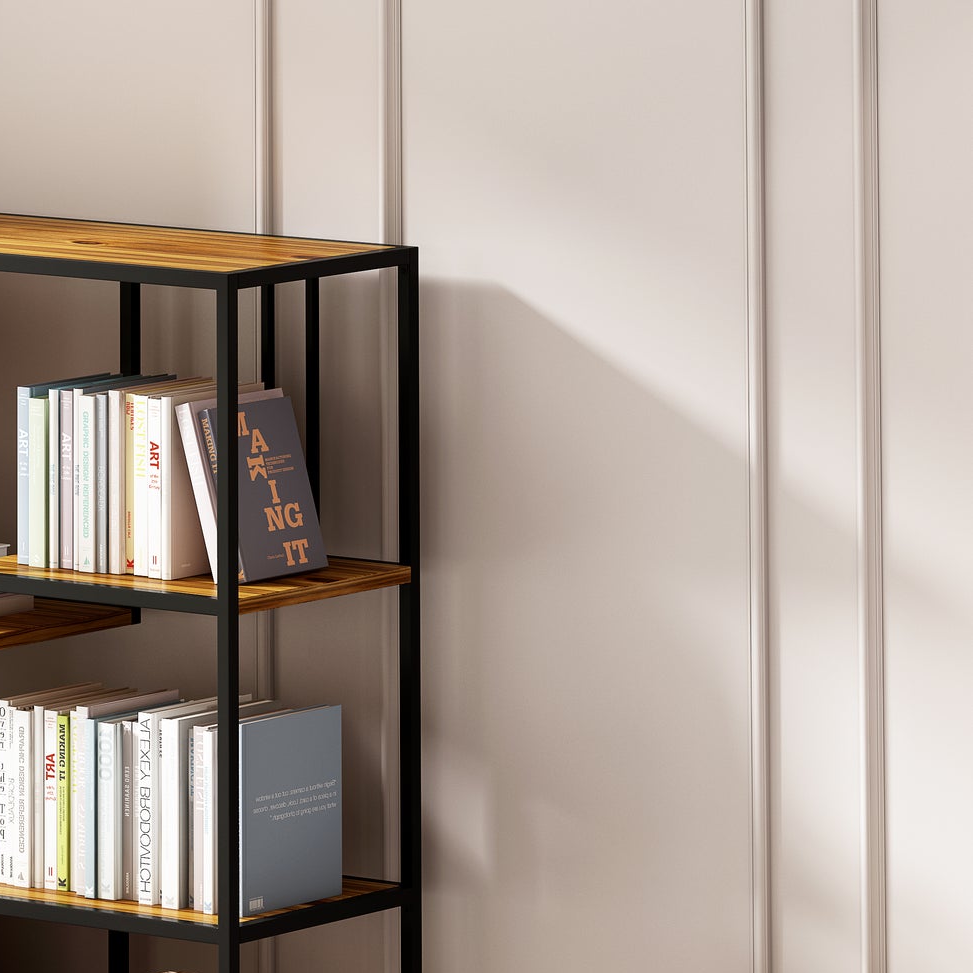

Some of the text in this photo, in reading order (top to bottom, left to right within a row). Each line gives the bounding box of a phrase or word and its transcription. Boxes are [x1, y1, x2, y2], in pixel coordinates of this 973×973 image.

[19, 429, 28, 456] ART
[62, 433, 71, 460] ART
[201, 418, 217, 461] MAKING
[150, 441, 159, 469] ART
[283, 539, 308, 566] IT
